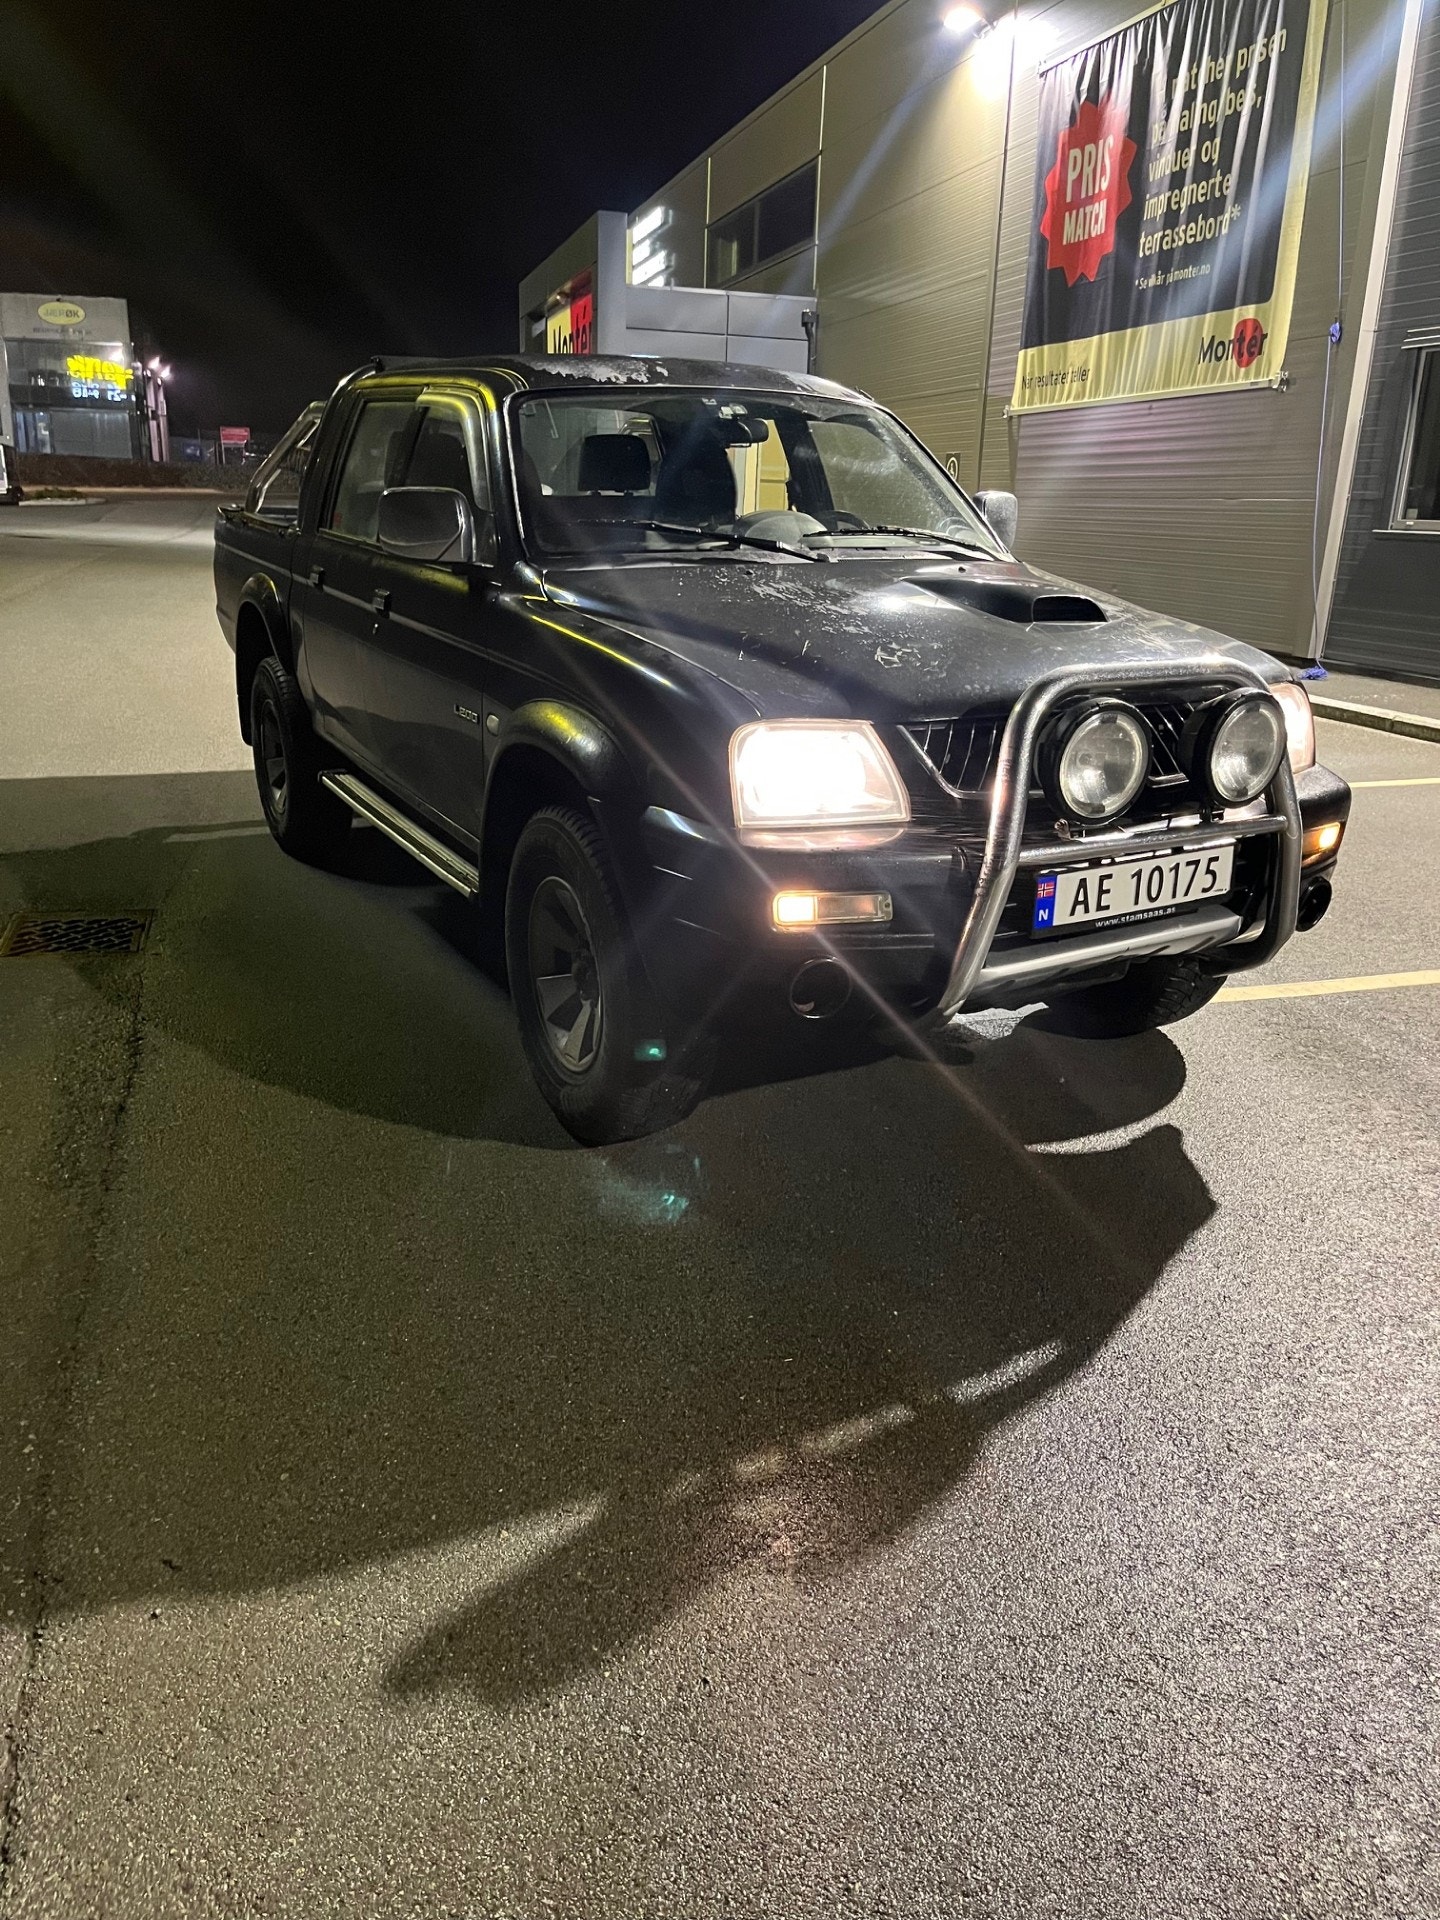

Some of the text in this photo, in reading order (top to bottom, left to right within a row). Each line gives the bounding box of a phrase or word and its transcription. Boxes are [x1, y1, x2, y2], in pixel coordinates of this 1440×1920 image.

[1066, 134, 1114, 203] PRIS
[1201, 137, 1220, 166] og
[1144, 169, 1232, 222] impregnerte
[1062, 198, 1108, 245] MATCH
[1198, 325, 1268, 364] Montér
[1069, 855, 1220, 917] AE 10175
[1038, 908, 1049, 921] N
[1095, 906, 1176, 928] www.stamsaas.as
